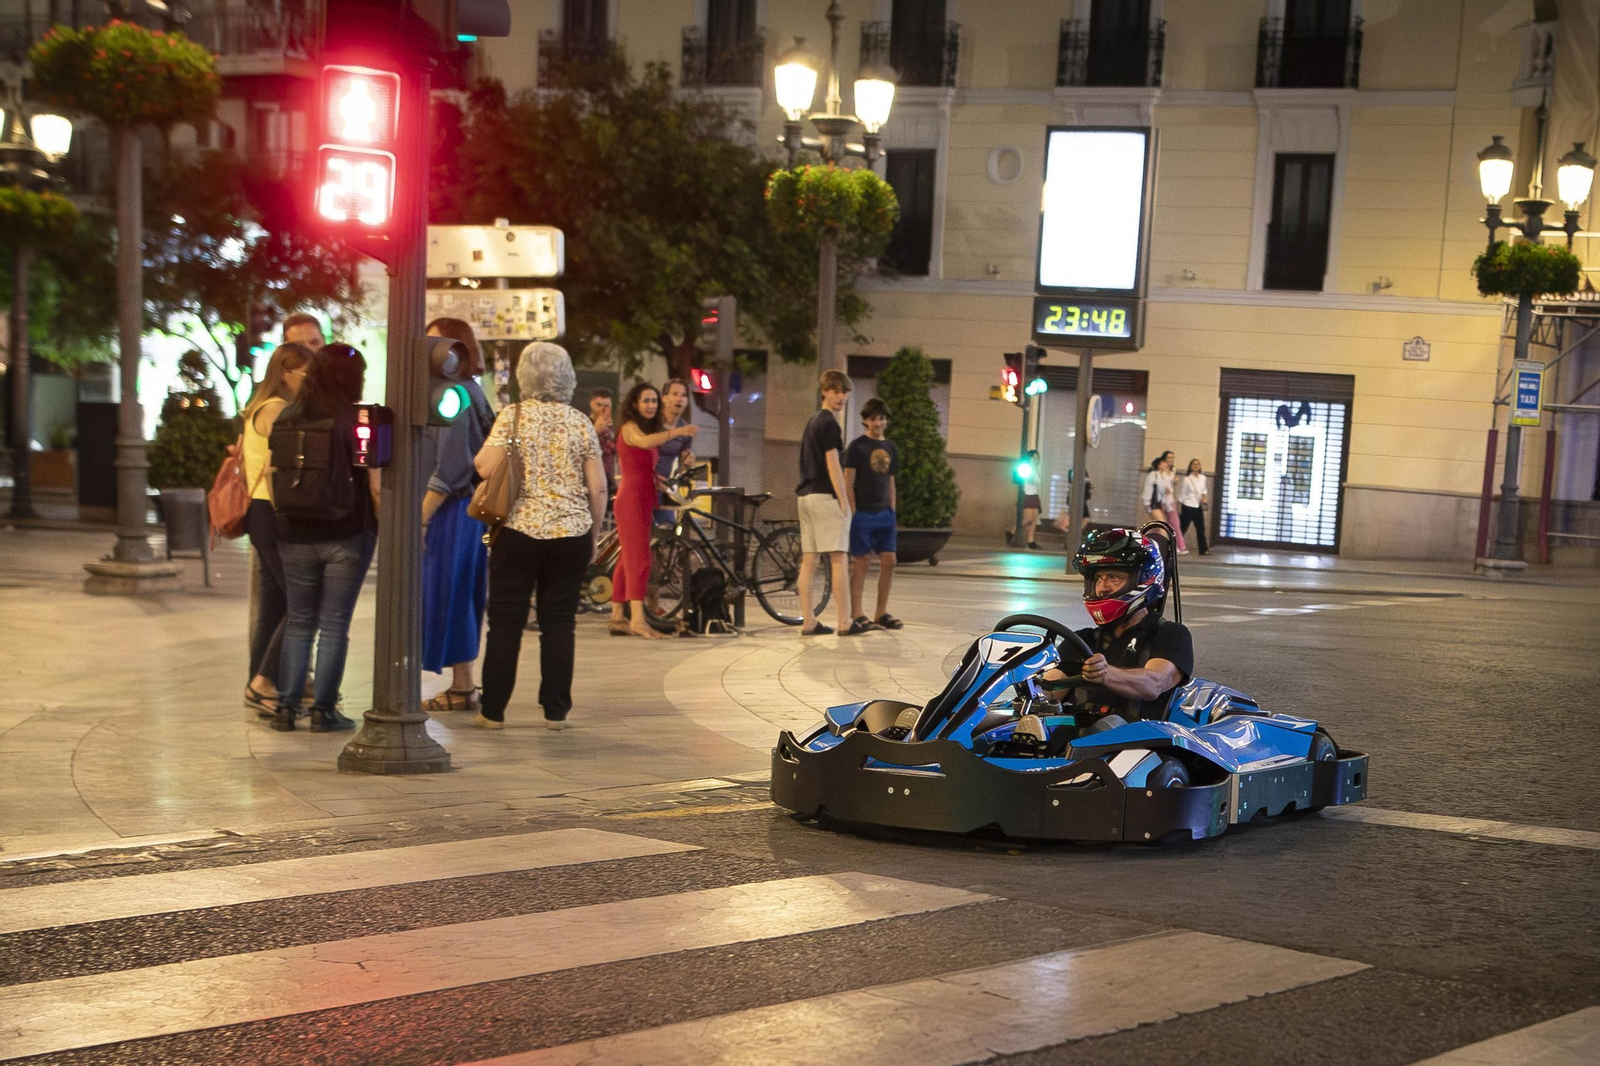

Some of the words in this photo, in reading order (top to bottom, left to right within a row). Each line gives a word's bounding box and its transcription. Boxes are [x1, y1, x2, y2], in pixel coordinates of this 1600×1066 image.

[319, 157, 388, 226] 29
[1044, 305, 1126, 335] 23:48
[997, 646, 1023, 661] 1
